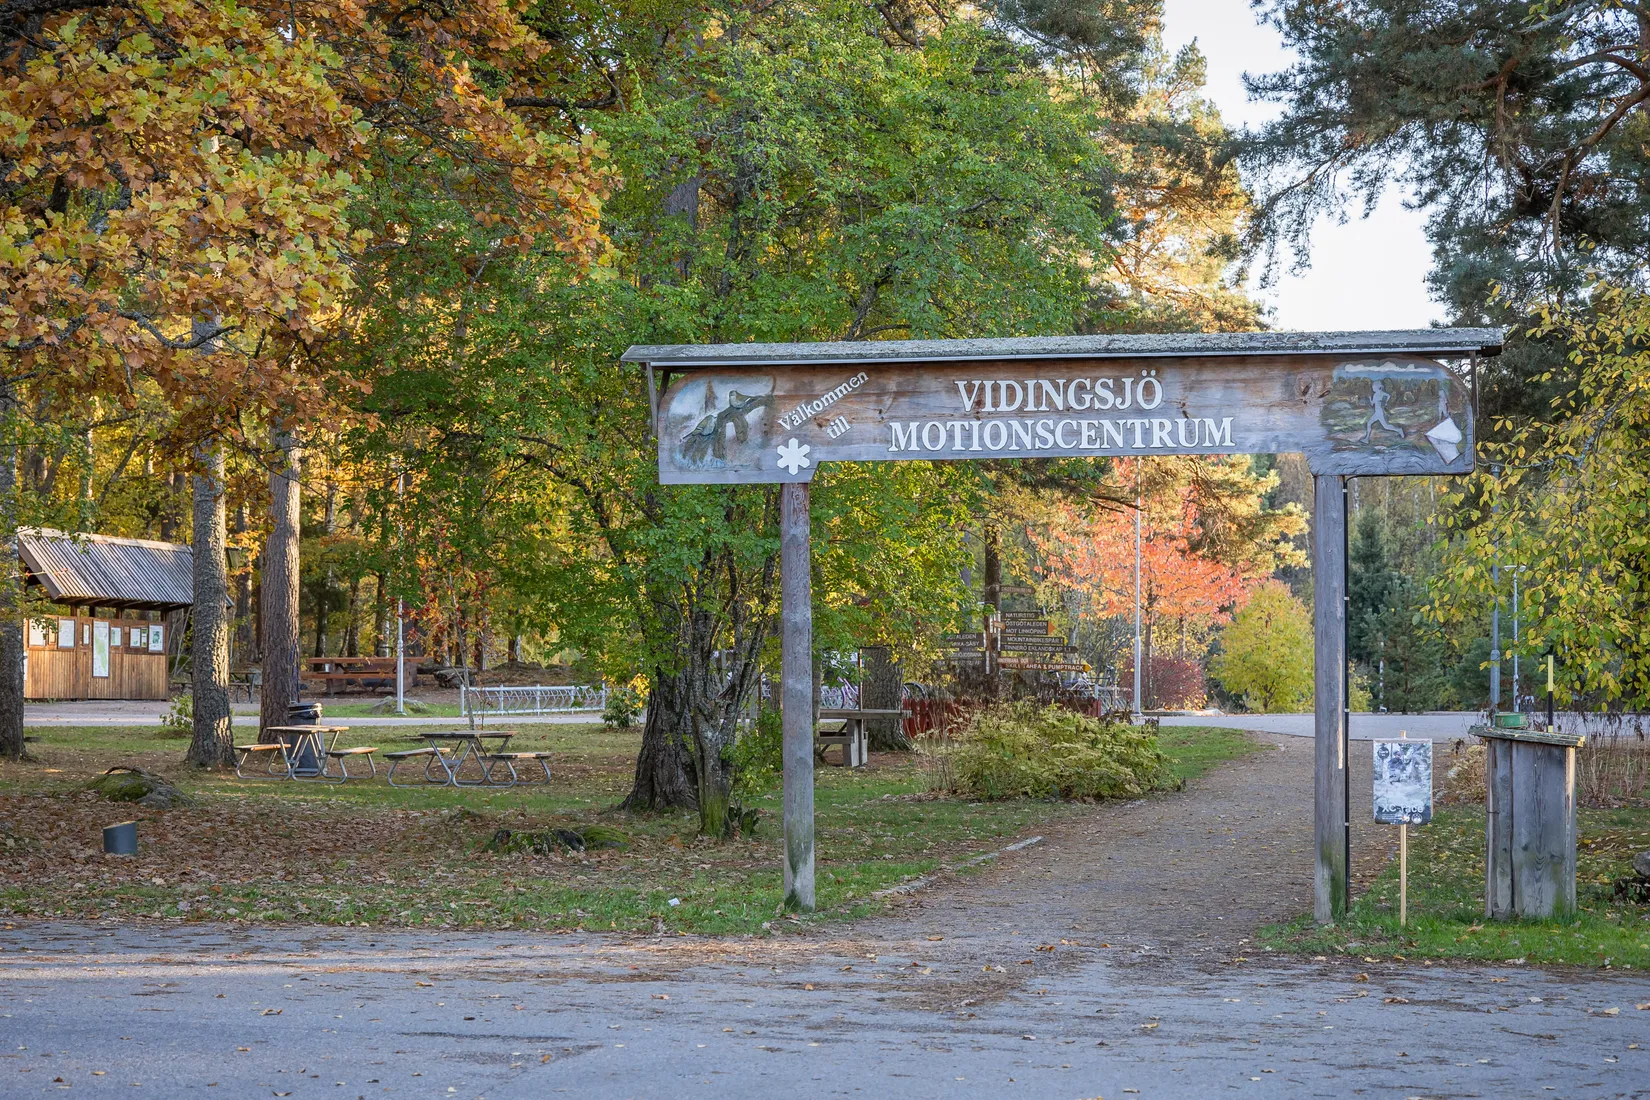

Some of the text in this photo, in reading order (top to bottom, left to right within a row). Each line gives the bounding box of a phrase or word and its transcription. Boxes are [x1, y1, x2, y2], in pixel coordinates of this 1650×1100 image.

[777, 370, 870, 433] Välkommen
[954, 369, 1163, 412] VIDINGSJÖ
[826, 416, 852, 440] till
[888, 417, 1236, 452] MOTIONSCENTRUM
[1018, 627, 1046, 635] LINKÖPING
[1382, 803, 1425, 813] XC-race
